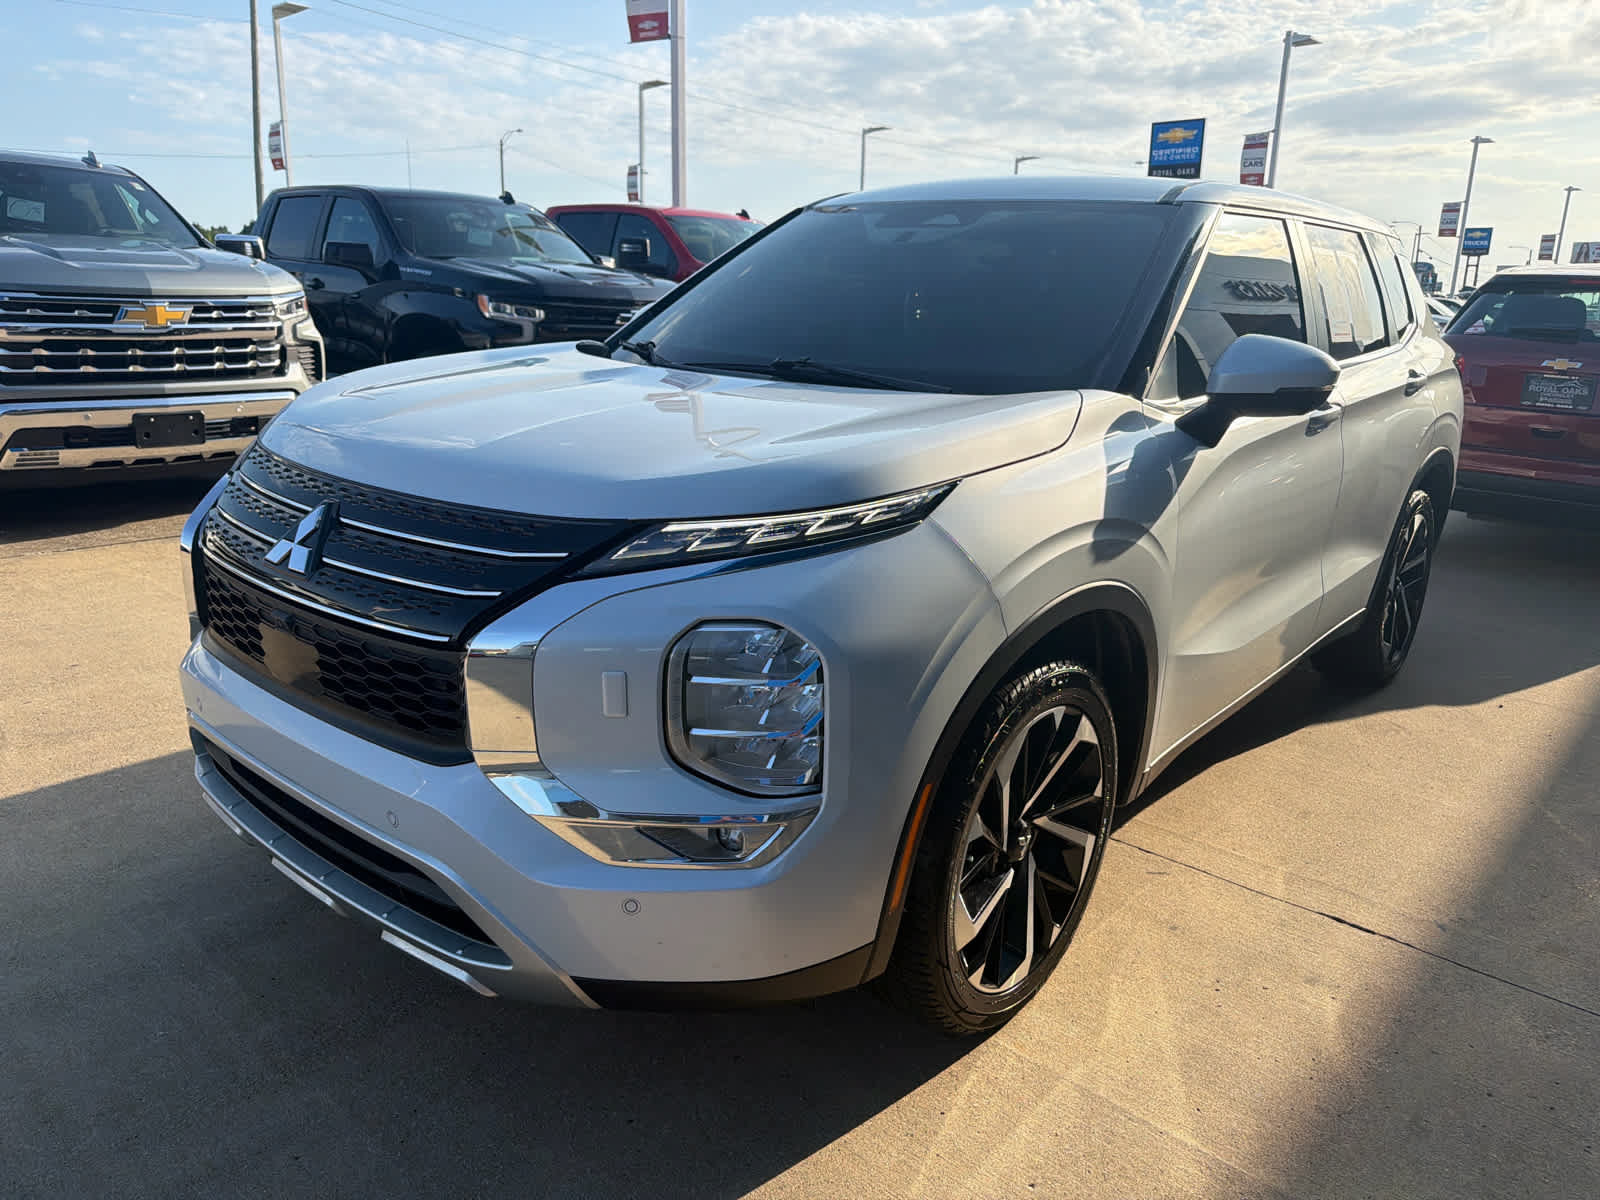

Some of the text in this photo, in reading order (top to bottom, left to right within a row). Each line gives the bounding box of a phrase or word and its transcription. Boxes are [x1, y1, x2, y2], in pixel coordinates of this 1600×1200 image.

[1243, 160, 1264, 168] CARS
[1528, 384, 1589, 396] ROYAL OAKS
